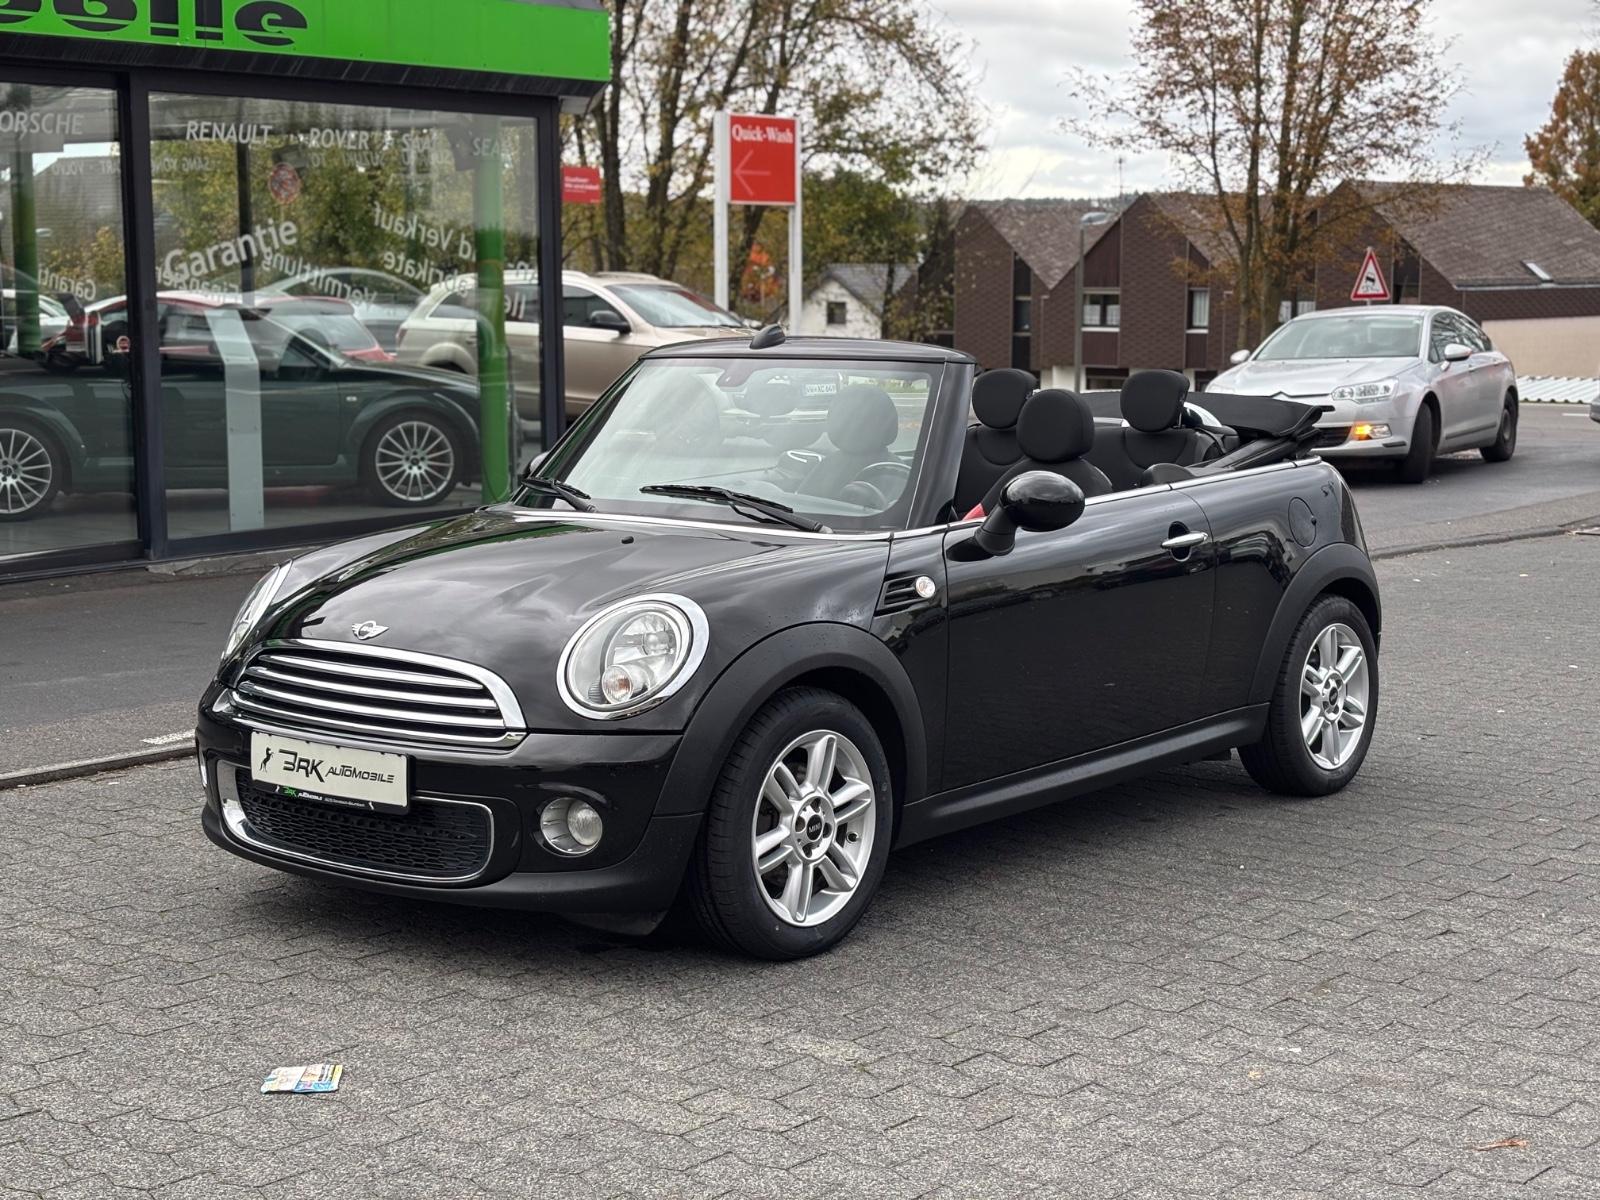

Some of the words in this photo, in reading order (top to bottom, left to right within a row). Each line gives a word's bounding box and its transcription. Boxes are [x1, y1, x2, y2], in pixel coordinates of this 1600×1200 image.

[186, 120, 273, 146] RENAULT
[308, 128, 370, 151] ROVER
[732, 124, 793, 143] Quick-Wash
[164, 218, 298, 283] Garantie
[325, 764, 395, 784] AUTOMOBILE
